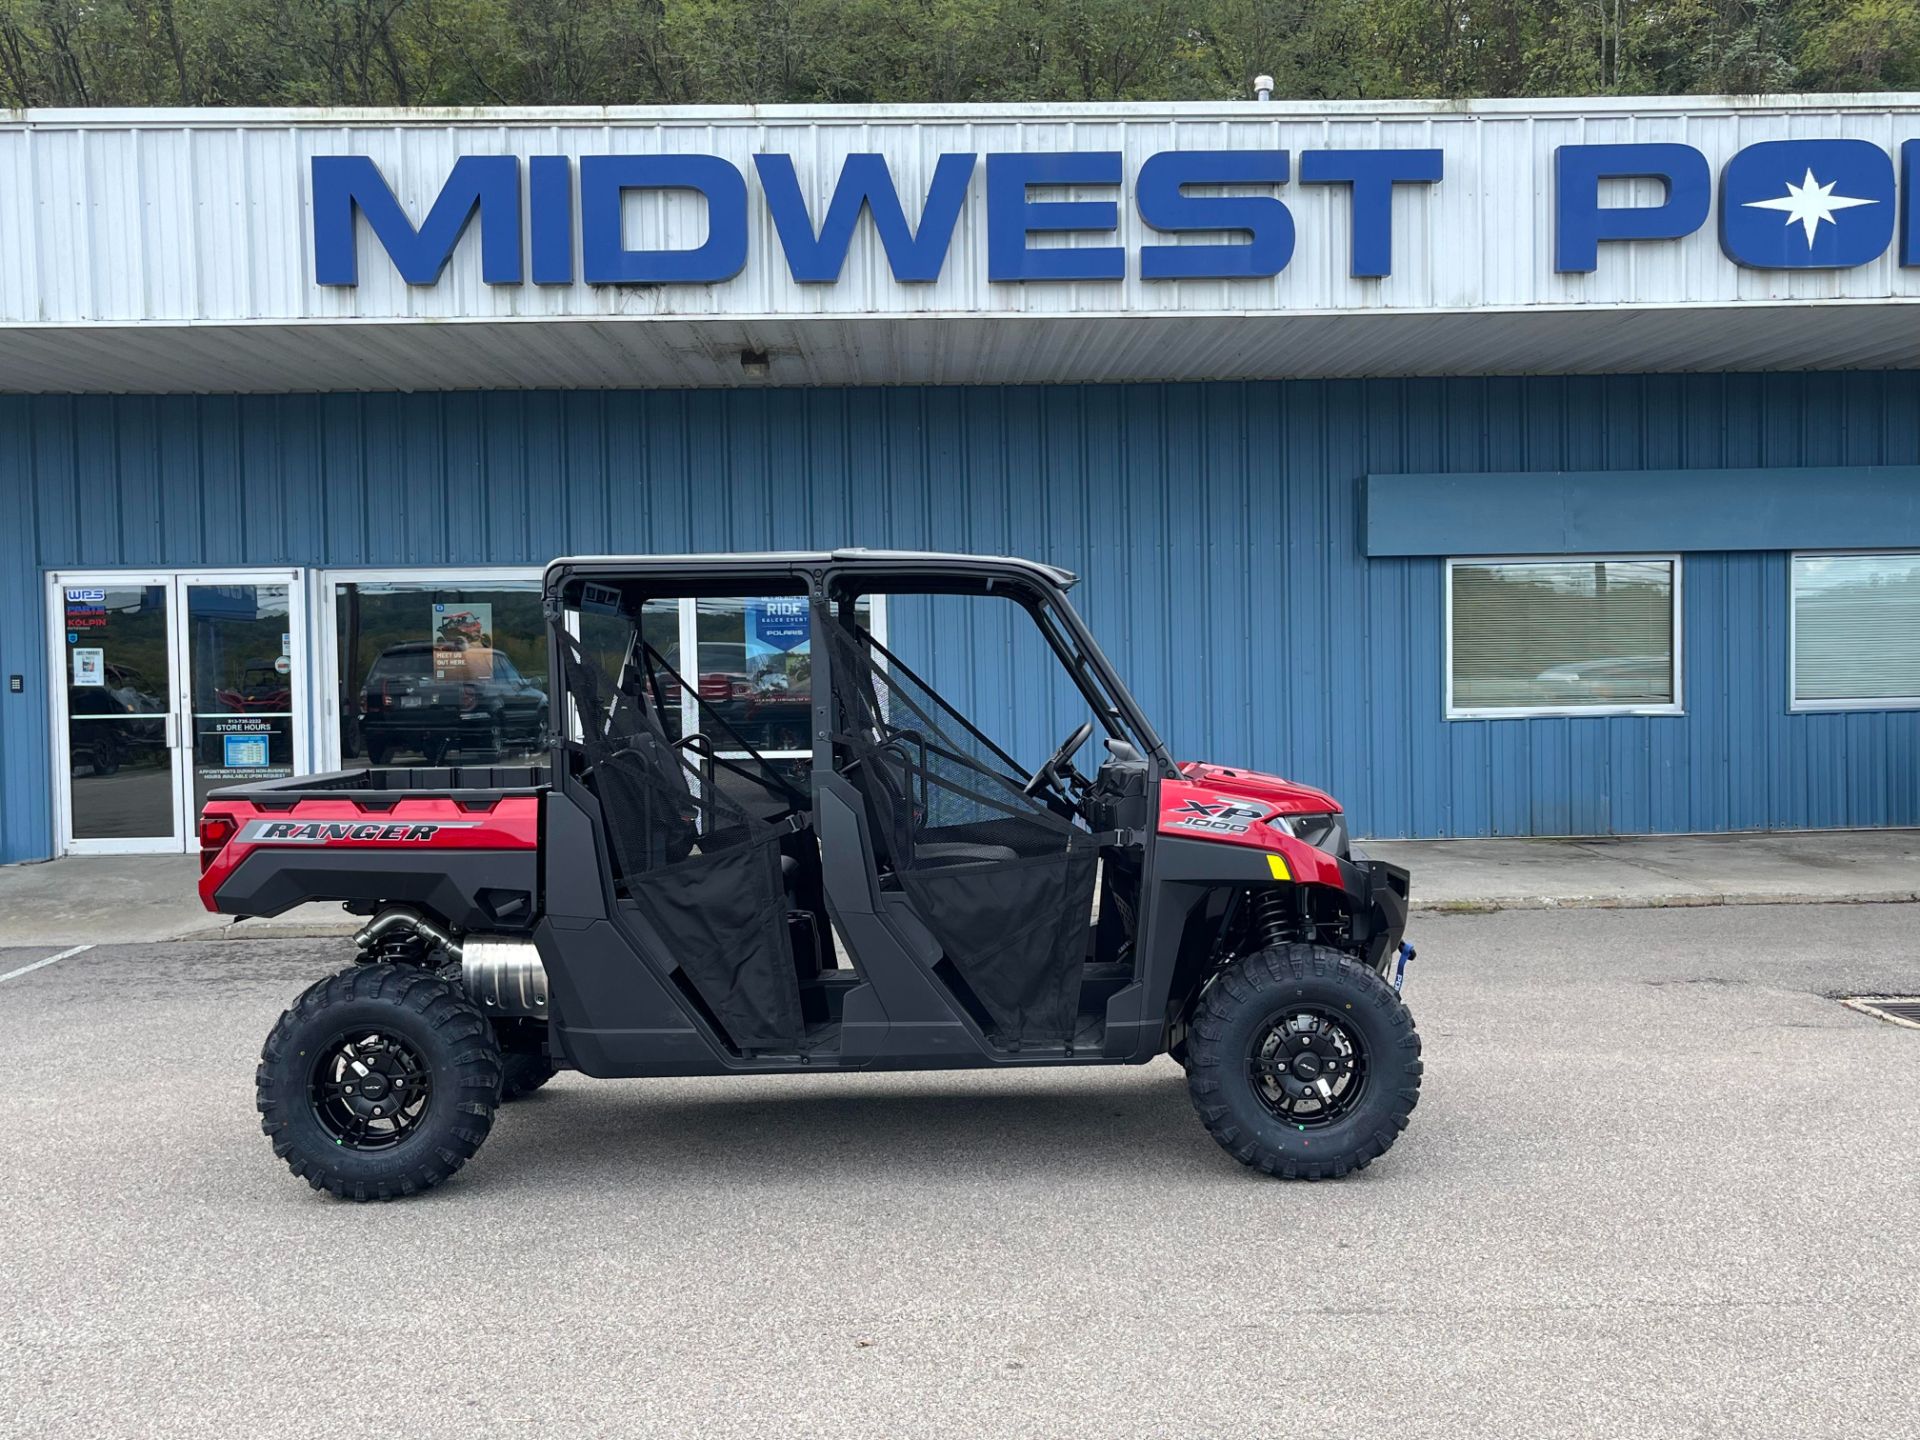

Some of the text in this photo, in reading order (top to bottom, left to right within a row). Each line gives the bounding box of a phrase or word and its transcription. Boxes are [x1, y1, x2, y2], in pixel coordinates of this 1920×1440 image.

[311, 138, 1920, 287] MIDWEST PO
[68, 590, 104, 600] WPS
[767, 602, 802, 616] RIDE
[67, 618, 106, 626] KOLPIN
[1174, 799, 1263, 819] XP
[261, 822, 439, 841] RANGER
[1184, 817, 1249, 832] 1000
